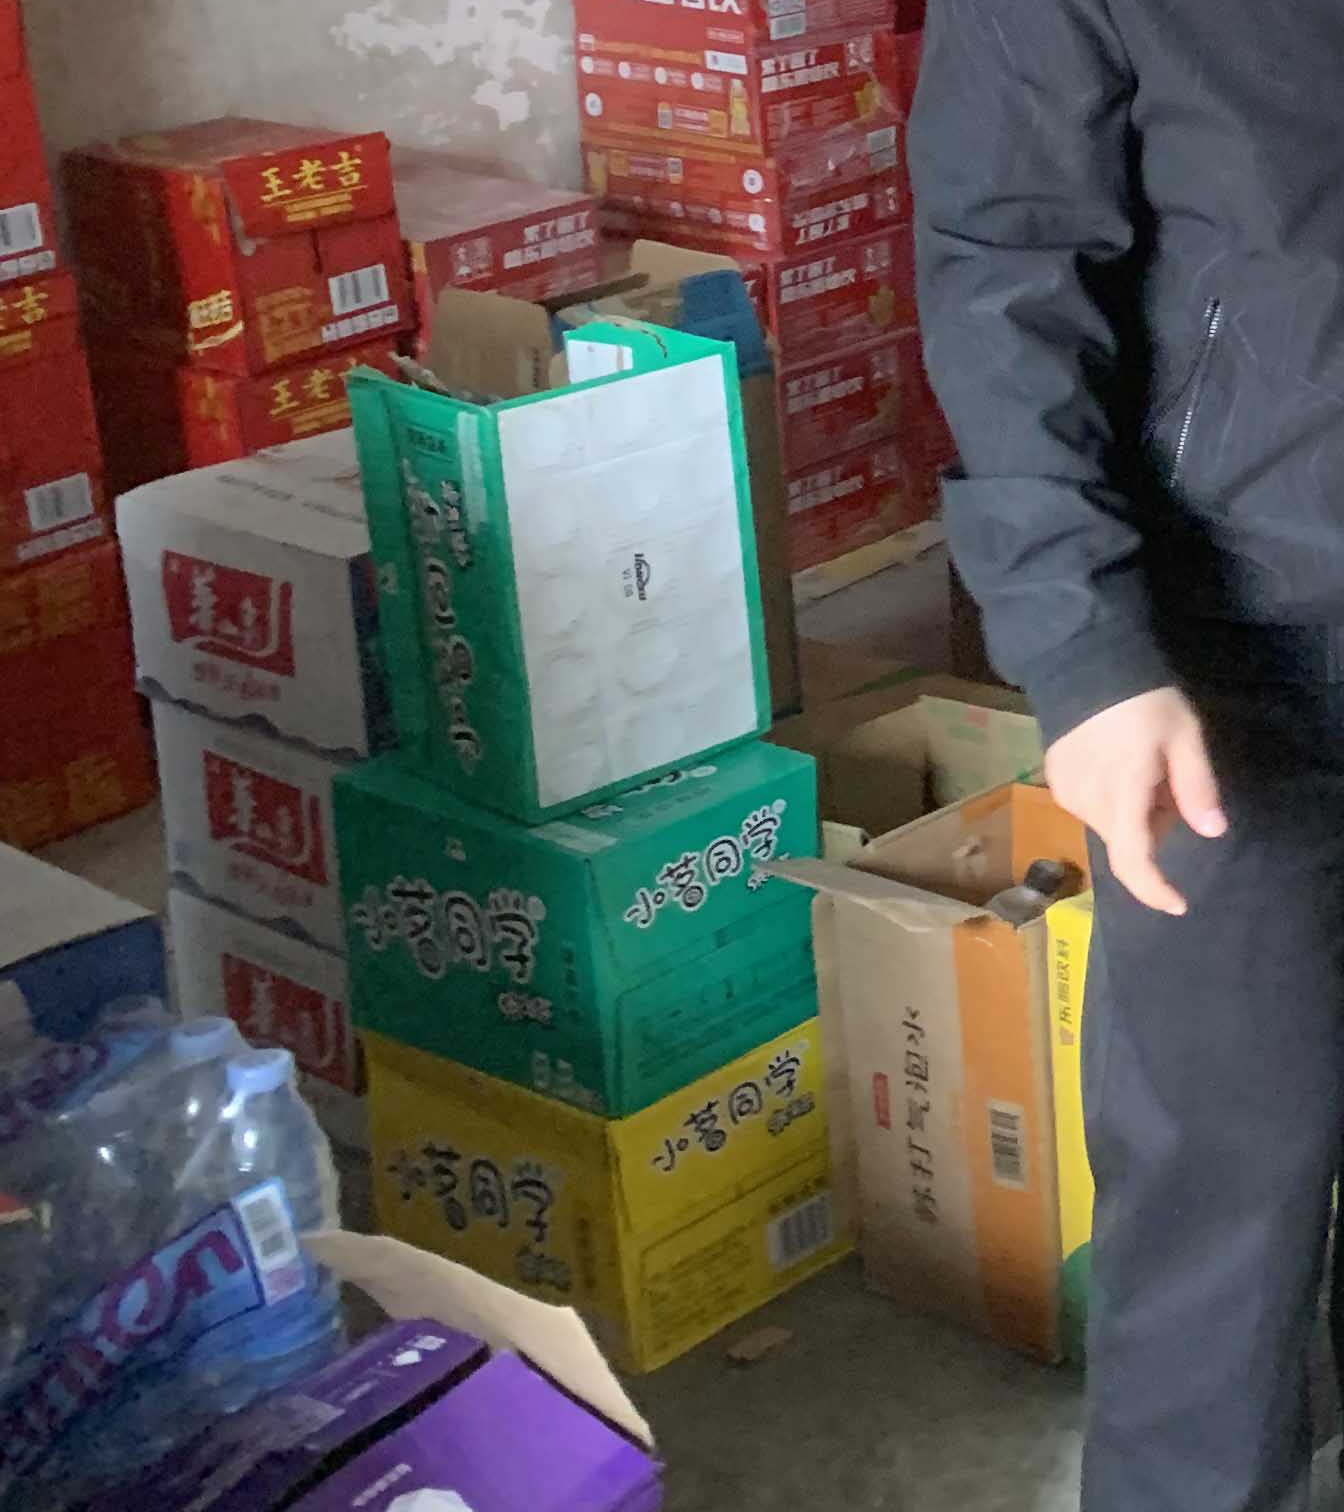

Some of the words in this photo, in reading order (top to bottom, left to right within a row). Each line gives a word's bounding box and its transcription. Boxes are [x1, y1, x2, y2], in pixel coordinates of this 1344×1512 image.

[260, 150, 364, 202] 王老吉
[622, 804, 783, 928] 小茗同学
[353, 876, 546, 980] 小茗同学
[651, 1050, 804, 1173] 小茗同学
